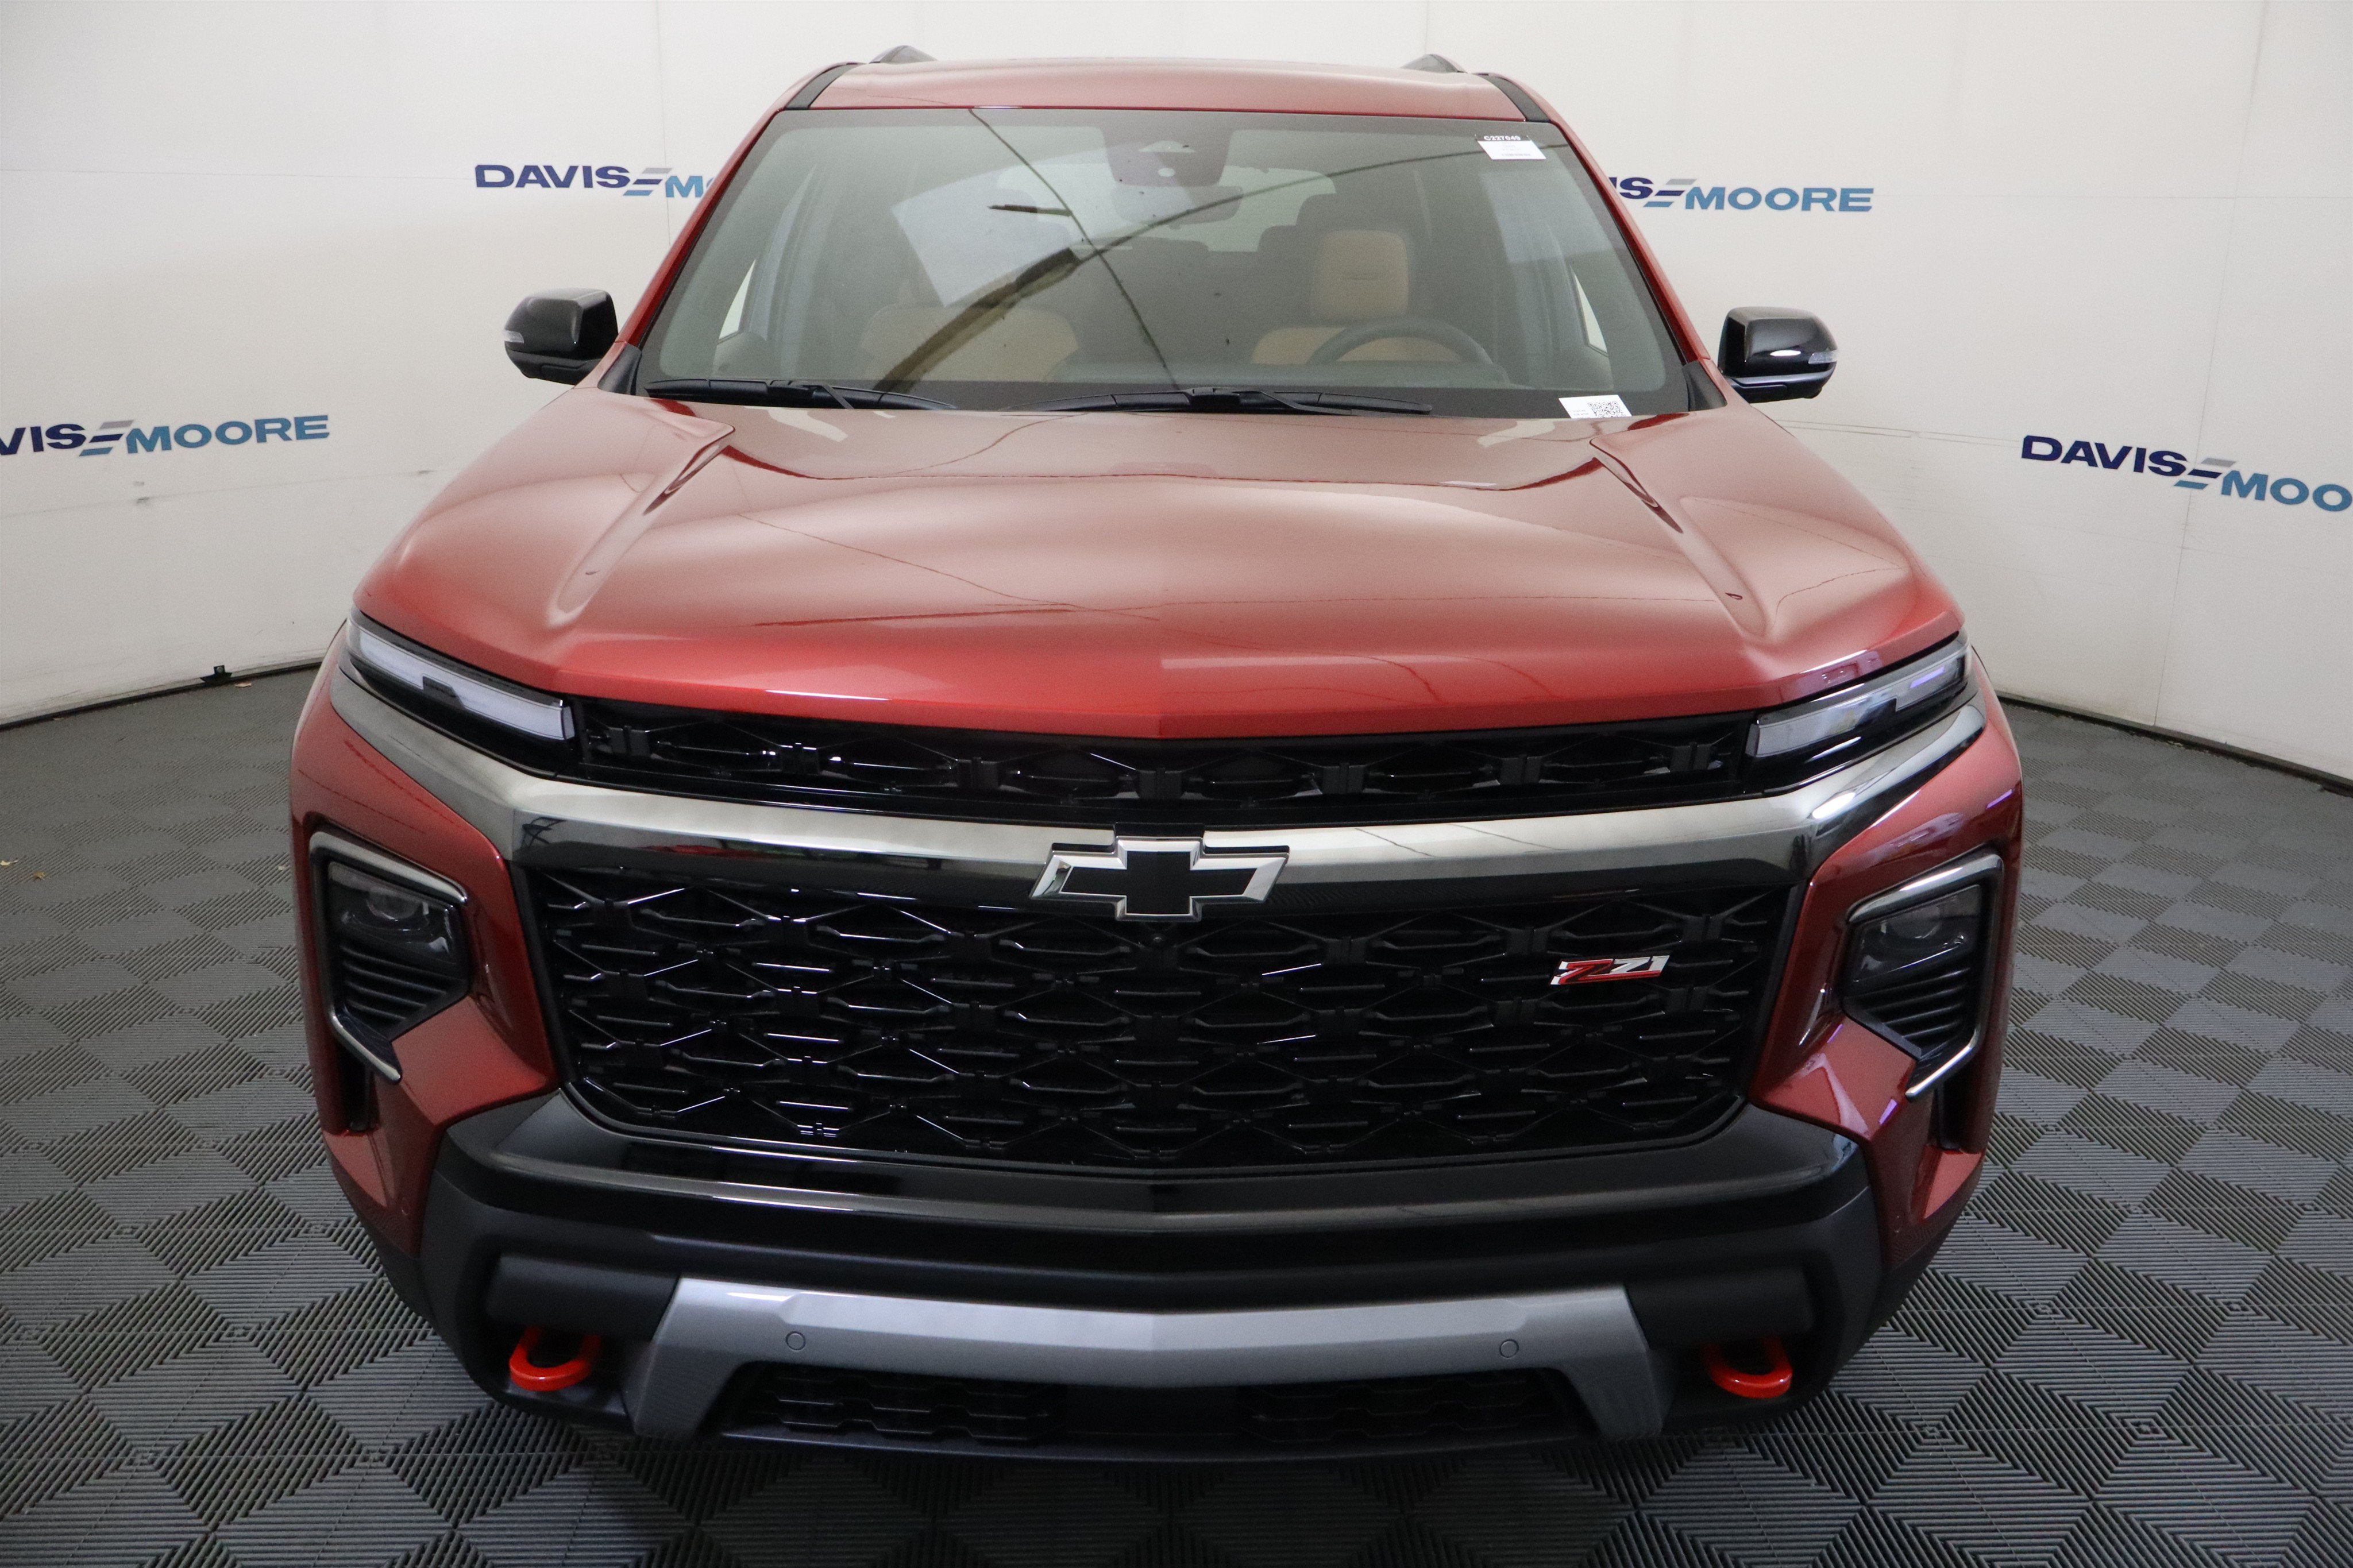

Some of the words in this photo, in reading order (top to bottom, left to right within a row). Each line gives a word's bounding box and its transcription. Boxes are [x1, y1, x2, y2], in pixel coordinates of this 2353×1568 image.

[475, 164, 630, 188] DAVIS
[665, 176, 714, 198] M
[1685, 187, 1874, 212] MOORE
[126, 415, 330, 454] MOORE
[2021, 435, 2189, 477] DAVIS
[2221, 470, 2352, 512] MOO
[1549, 955, 1671, 986] Z71
